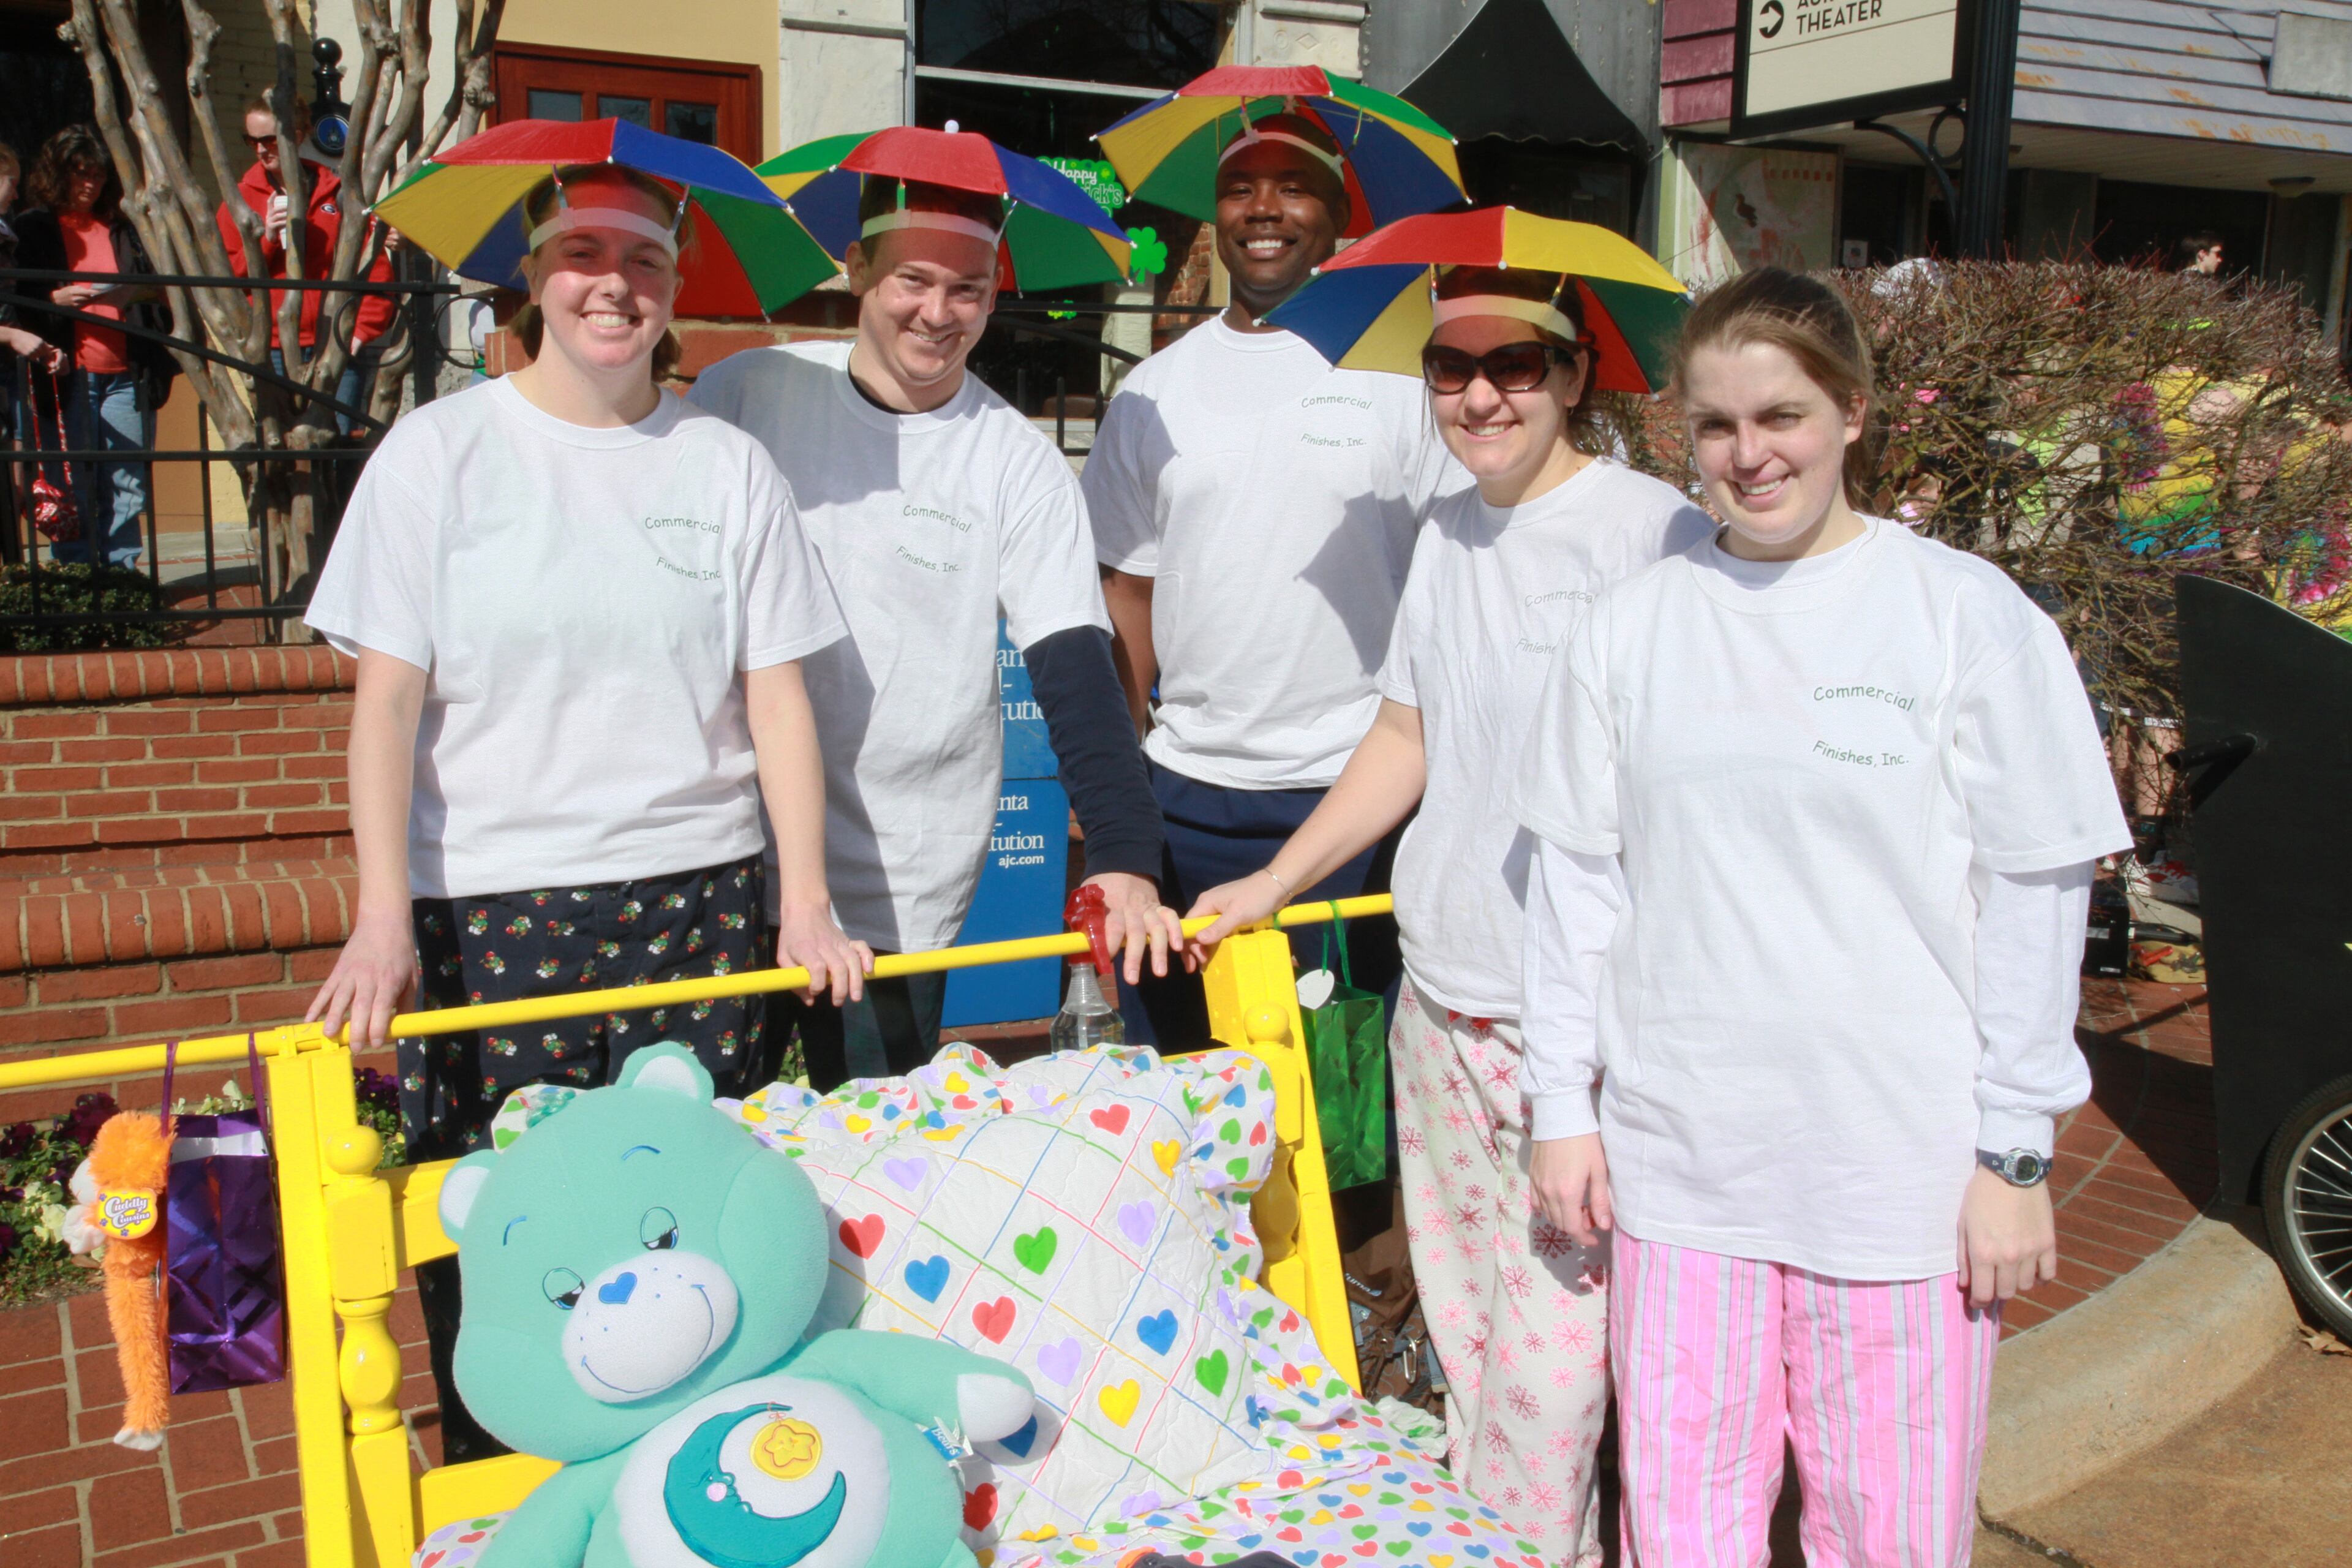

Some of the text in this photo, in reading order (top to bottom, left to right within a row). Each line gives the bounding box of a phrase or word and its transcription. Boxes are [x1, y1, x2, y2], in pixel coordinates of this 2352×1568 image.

[1796, 0, 1882, 35] THEATER
[1053, 160, 1097, 185] Happy
[1301, 395, 1373, 410] Commercial
[1300, 432, 1367, 448] Finishes, Inc.
[645, 516, 724, 536] Commercial
[903, 504, 972, 533] Commercial
[656, 556, 701, 581] Finishes,
[895, 545, 962, 573] Finishes, Inc.
[1524, 590, 1600, 608] Commercal
[1813, 685, 1915, 712] Commercial
[1812, 739, 1909, 768] Finishes, Inc.
[998, 854, 1044, 869] ajc.com
[105, 1196, 148, 1218] Cuddly
[111, 1212, 150, 1229] Cousins
